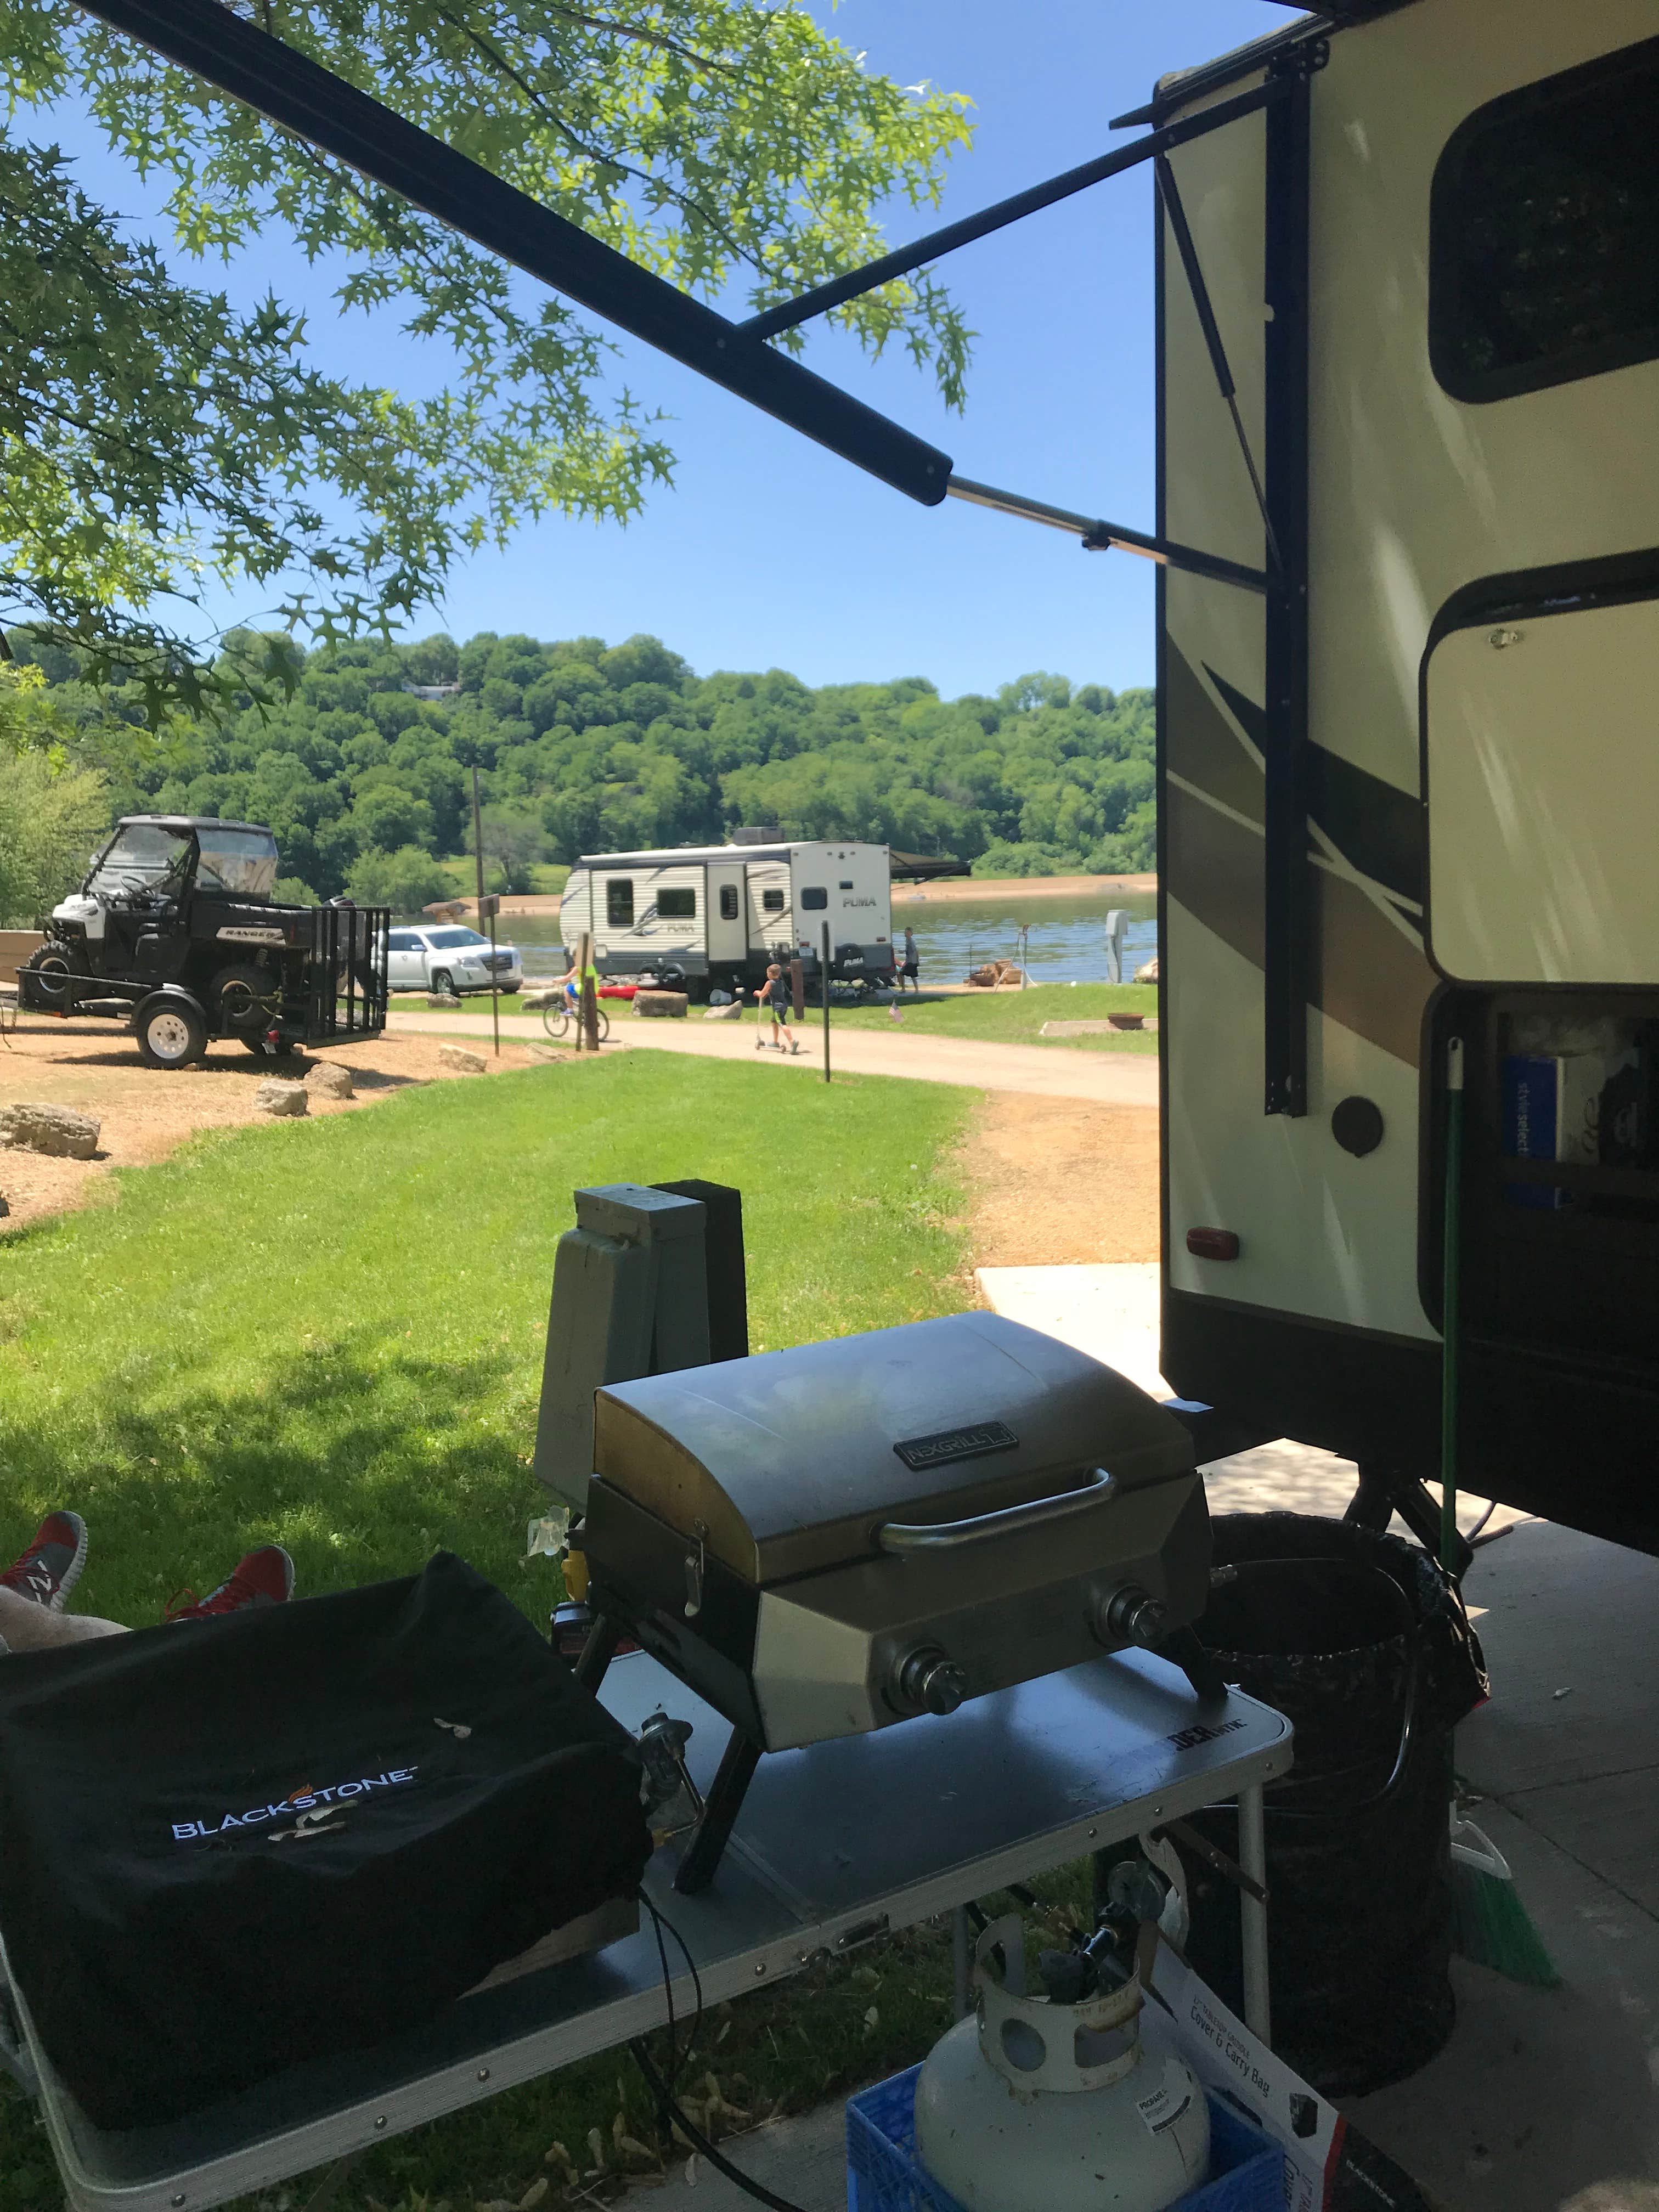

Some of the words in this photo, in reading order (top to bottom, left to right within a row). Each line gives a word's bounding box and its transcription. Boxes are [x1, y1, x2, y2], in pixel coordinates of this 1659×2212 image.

[843, 896, 877, 907] PUMA
[225, 930, 275, 938] RANGER
[843, 957, 864, 967] PUMA
[907, 1434, 986, 1460] NEXGRILL
[172, 1768, 414, 1839] BLACKSTONE
[1190, 2005, 1215, 2039] Cover
[1225, 2042, 1250, 2076] Carry
[1251, 2067, 1269, 2098] Bag
[1139, 2090, 1164, 2110] PROPANE
